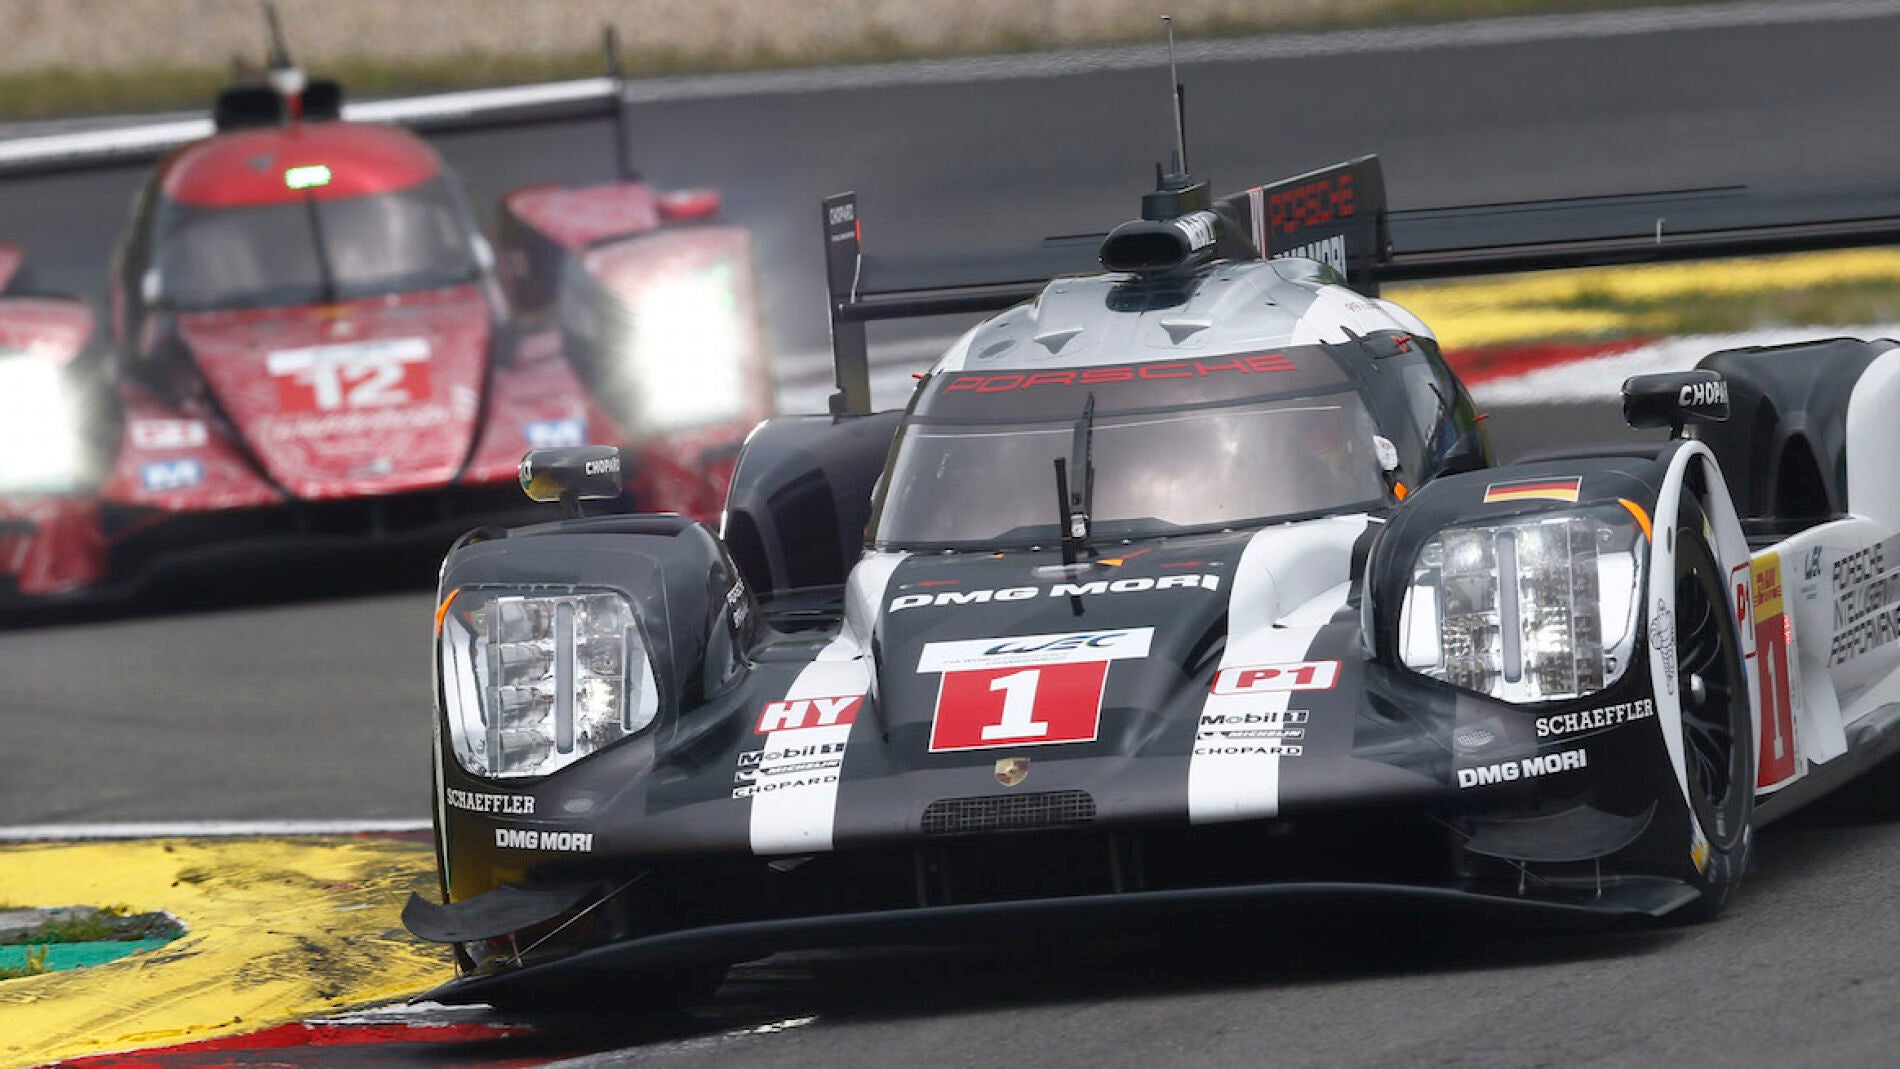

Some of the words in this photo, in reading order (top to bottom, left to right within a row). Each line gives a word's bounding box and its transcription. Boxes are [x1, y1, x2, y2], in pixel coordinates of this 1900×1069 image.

[1269, 174, 1355, 235] PORSCHE
[942, 353, 1297, 396] PORSCHE
[889, 586, 1039, 613] DMG
[1050, 574, 1220, 598] MORI
[1236, 666, 1316, 688] P1
[759, 697, 860, 732] HY
[980, 669, 1049, 741] 1
[1201, 712, 1277, 725] Mobil
[1535, 698, 1654, 737] SCHAEFFLER
[1767, 640, 1784, 760] 1
[1195, 747, 1300, 755] CHOPARD
[1458, 763, 1519, 788] DMG
[1522, 749, 1587, 777] MORI
[446, 787, 535, 814] SCHAEFFLER
[735, 776, 837, 796] CHOPARD
[496, 828, 538, 848] DMG
[541, 832, 593, 852] MORI
